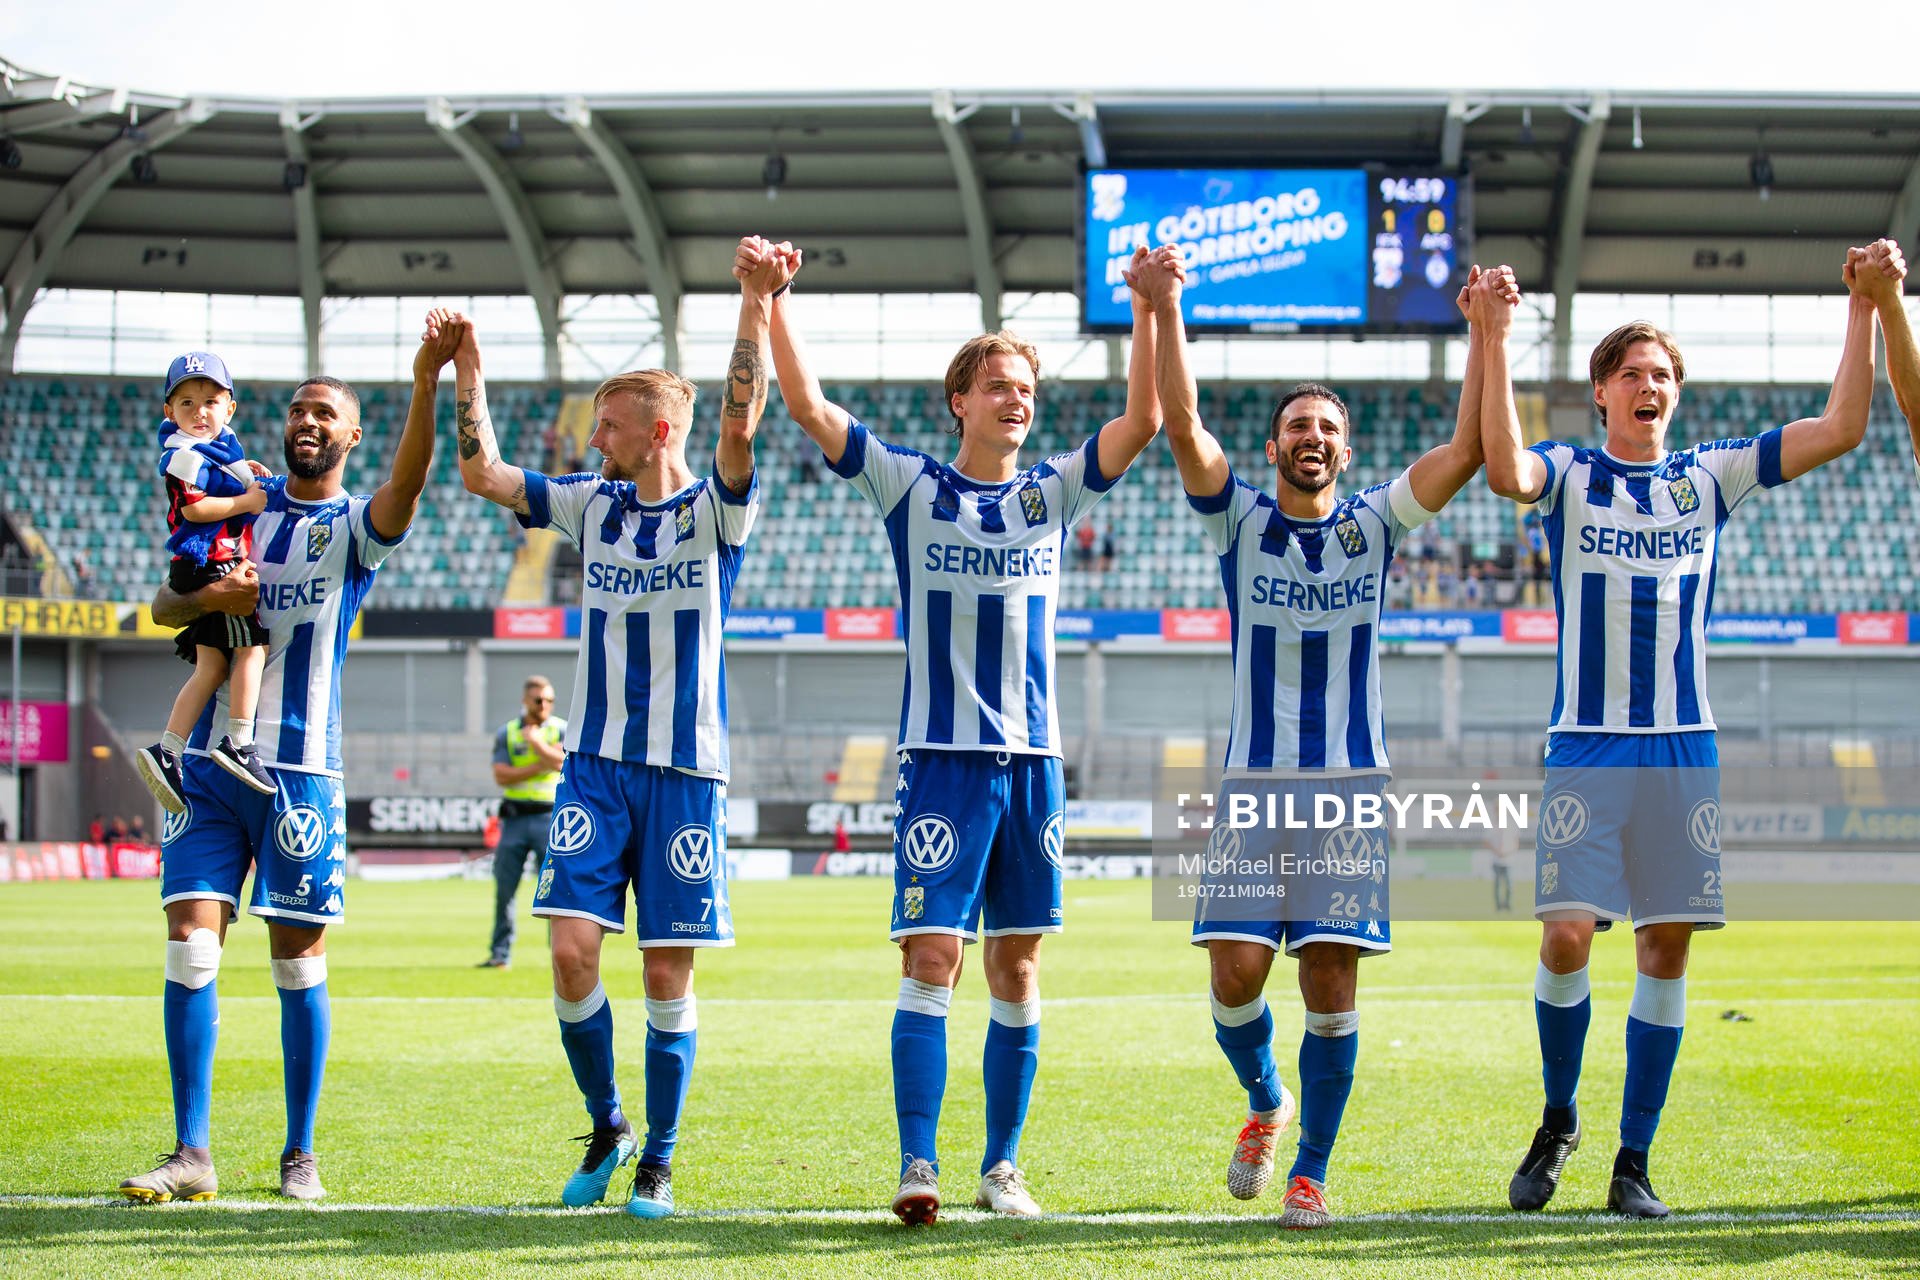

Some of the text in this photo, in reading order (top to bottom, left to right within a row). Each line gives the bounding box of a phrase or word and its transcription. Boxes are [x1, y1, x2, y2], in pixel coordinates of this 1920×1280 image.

[1156, 188, 1320, 243] GÖTEBORG
[1382, 209, 1395, 233] 1
[1181, 211, 1347, 271] ORRKÖPING
[143, 248, 187, 265] P1
[402, 251, 454, 270] P2
[185, 354, 204, 373] LA
[1579, 524, 1704, 560] SERNEKE
[925, 543, 1053, 577] SERNEKE
[587, 559, 704, 595] SERNEKE
[259, 576, 326, 611] NEKE
[1251, 573, 1376, 612] SERNEKE
[369, 797, 501, 832] SERNEK
[806, 802, 896, 834] SELEC
[278, 808, 323, 857] VW
[905, 819, 954, 869] VW
[268, 892, 308, 906] Kappa
[295, 874, 313, 896] 5
[701, 898, 713, 922] 7
[1330, 891, 1361, 918] 26
[1688, 896, 1724, 908] Kapp
[672, 922, 712, 934] Kappa
[1316, 918, 1359, 930] Kappa
